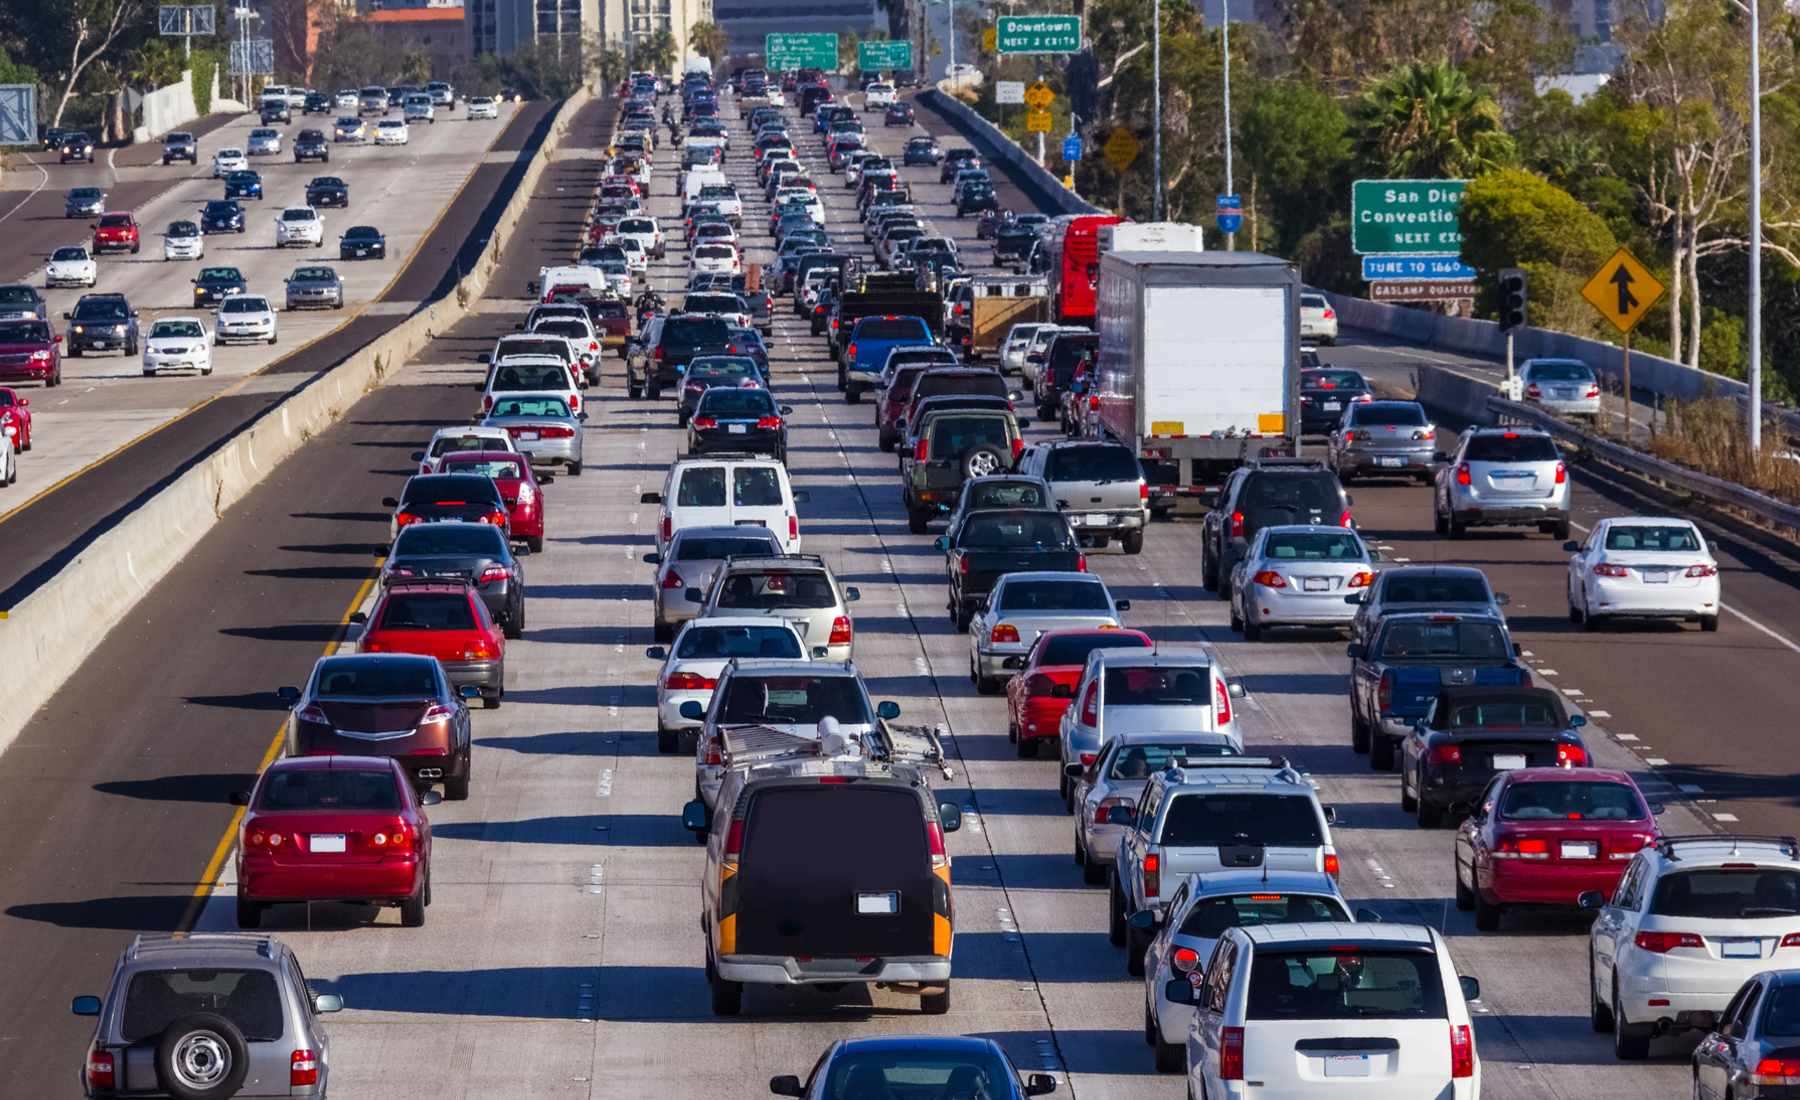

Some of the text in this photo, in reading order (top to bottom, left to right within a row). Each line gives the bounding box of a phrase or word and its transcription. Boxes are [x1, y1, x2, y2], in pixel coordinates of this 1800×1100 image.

[1007, 22, 1071, 32] Downtown
[1004, 38, 1028, 46] NEXT
[1045, 37, 1075, 46] EXITS
[1385, 189, 1418, 202] San
[1361, 209, 1454, 223] Conventio
[1395, 232, 1430, 243] NEXT
[1369, 262, 1402, 272] TUNE
[1409, 262, 1426, 272] TO
[1375, 285, 1424, 295] GASLAMP
